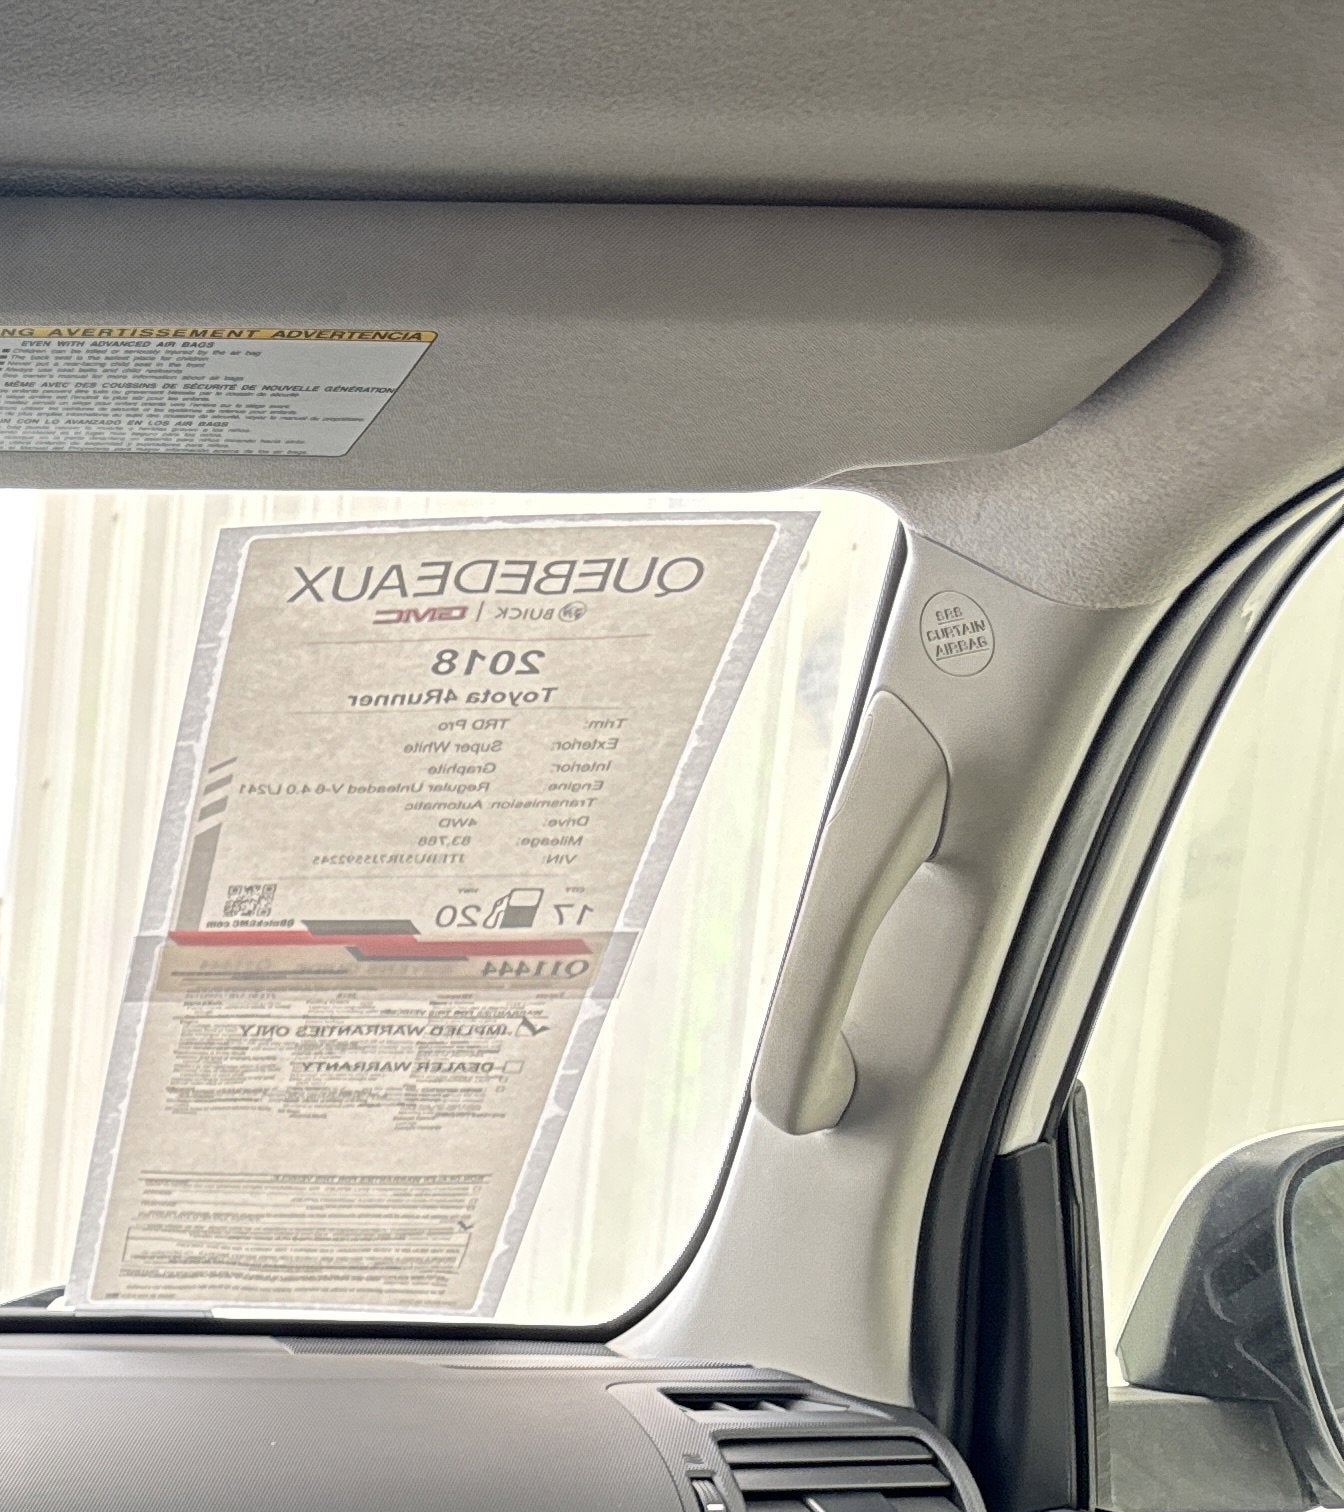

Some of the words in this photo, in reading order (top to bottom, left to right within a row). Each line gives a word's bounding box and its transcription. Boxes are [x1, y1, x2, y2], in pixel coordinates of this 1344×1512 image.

[48, 328, 261, 339] AVERTISSEMENT
[270, 330, 423, 341] ADVERTENCIA
[926, 619, 986, 642] CURTAIN
[935, 635, 988, 657] AIRBAG
